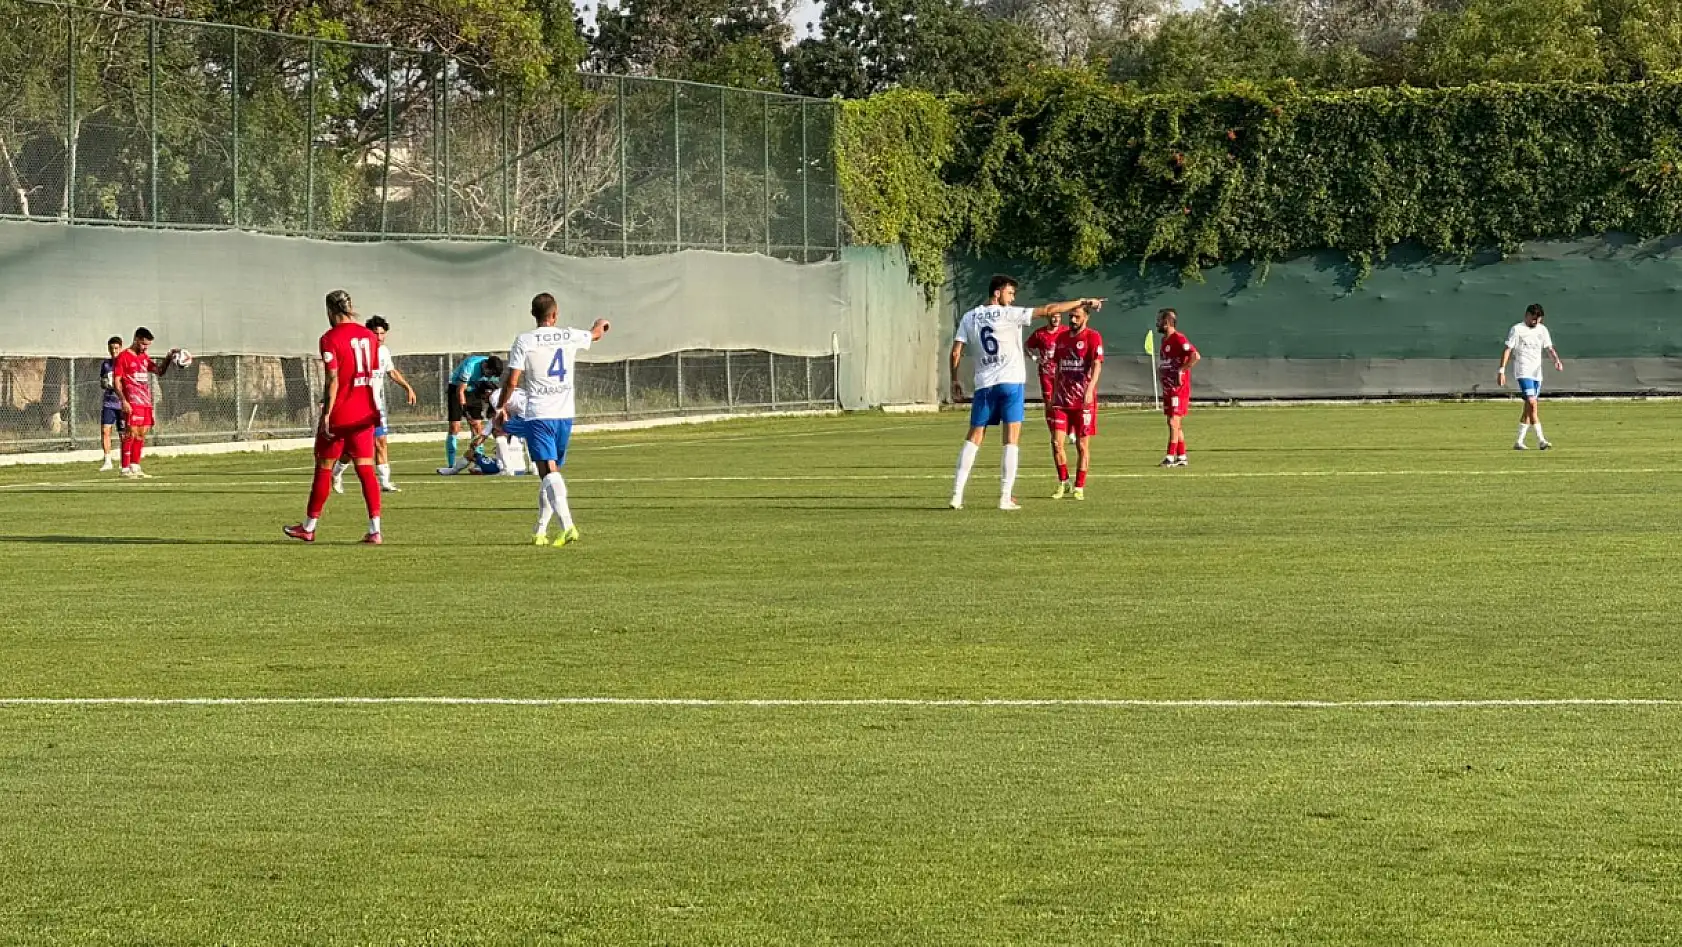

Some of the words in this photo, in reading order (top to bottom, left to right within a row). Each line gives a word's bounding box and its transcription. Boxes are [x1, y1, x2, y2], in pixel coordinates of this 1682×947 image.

[350, 337, 370, 373] 11
[980, 326, 999, 356] 6
[547, 347, 567, 382] 4
